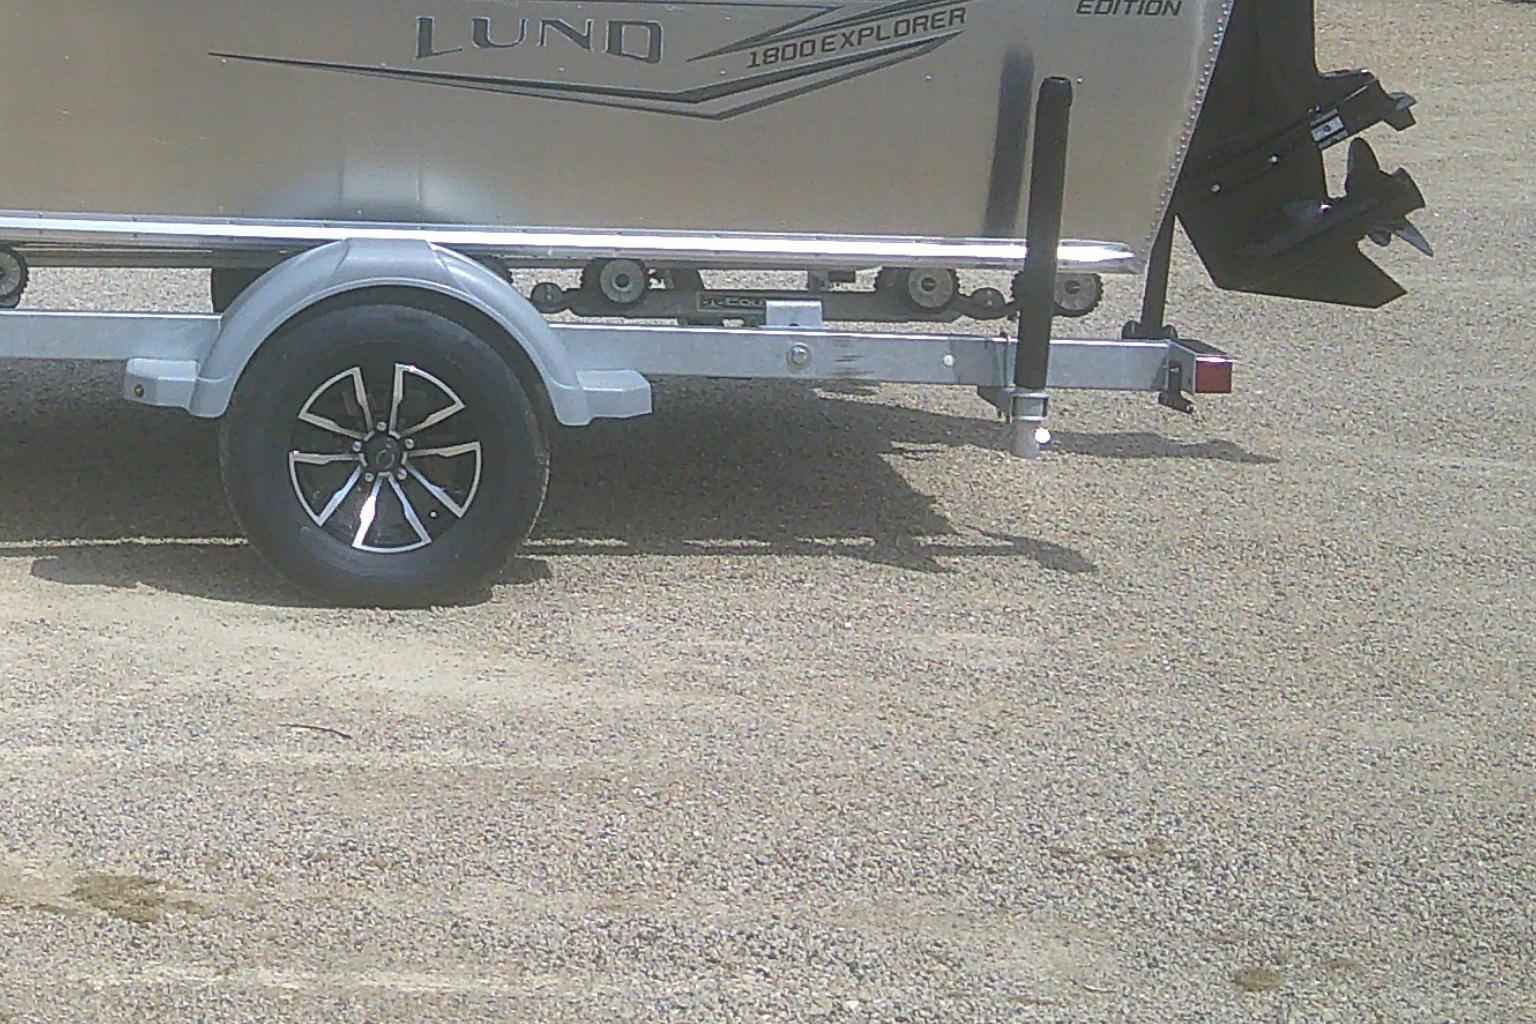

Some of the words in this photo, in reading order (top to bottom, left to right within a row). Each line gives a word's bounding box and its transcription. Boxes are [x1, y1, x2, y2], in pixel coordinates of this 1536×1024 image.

[414, 16, 664, 65] LUND
[746, 40, 816, 69] 1800
[821, 7, 967, 53] EXPLORER
